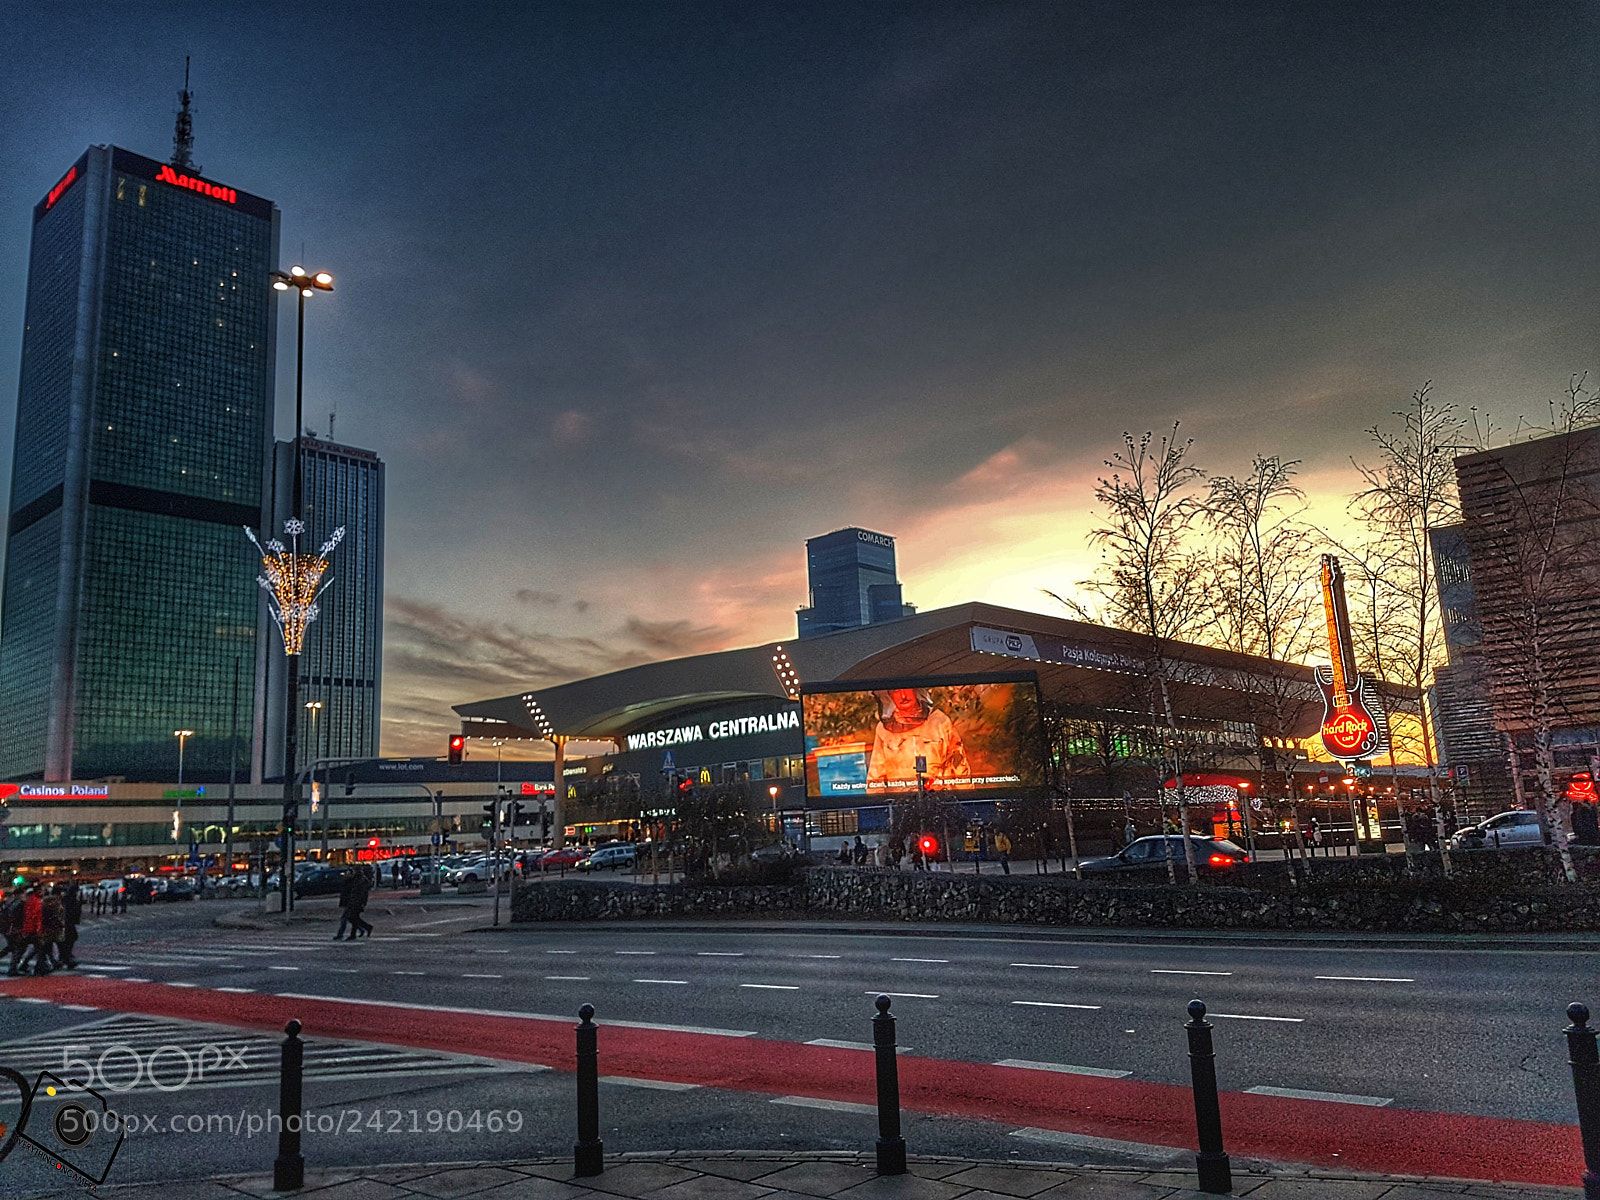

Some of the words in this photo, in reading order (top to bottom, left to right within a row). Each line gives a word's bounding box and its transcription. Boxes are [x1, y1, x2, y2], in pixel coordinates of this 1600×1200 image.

[155, 165, 237, 204] Marriott
[857, 530, 894, 549] COMARCH
[1062, 645, 1084, 661] Pasja
[627, 725, 703, 750] WARSZAWA
[708, 710, 800, 739] CENTRALNA
[1345, 719, 1368, 735] Rock
[563, 766, 587, 776] cDonald's
[20, 784, 65, 796] Casinos
[71, 784, 108, 796] Poland
